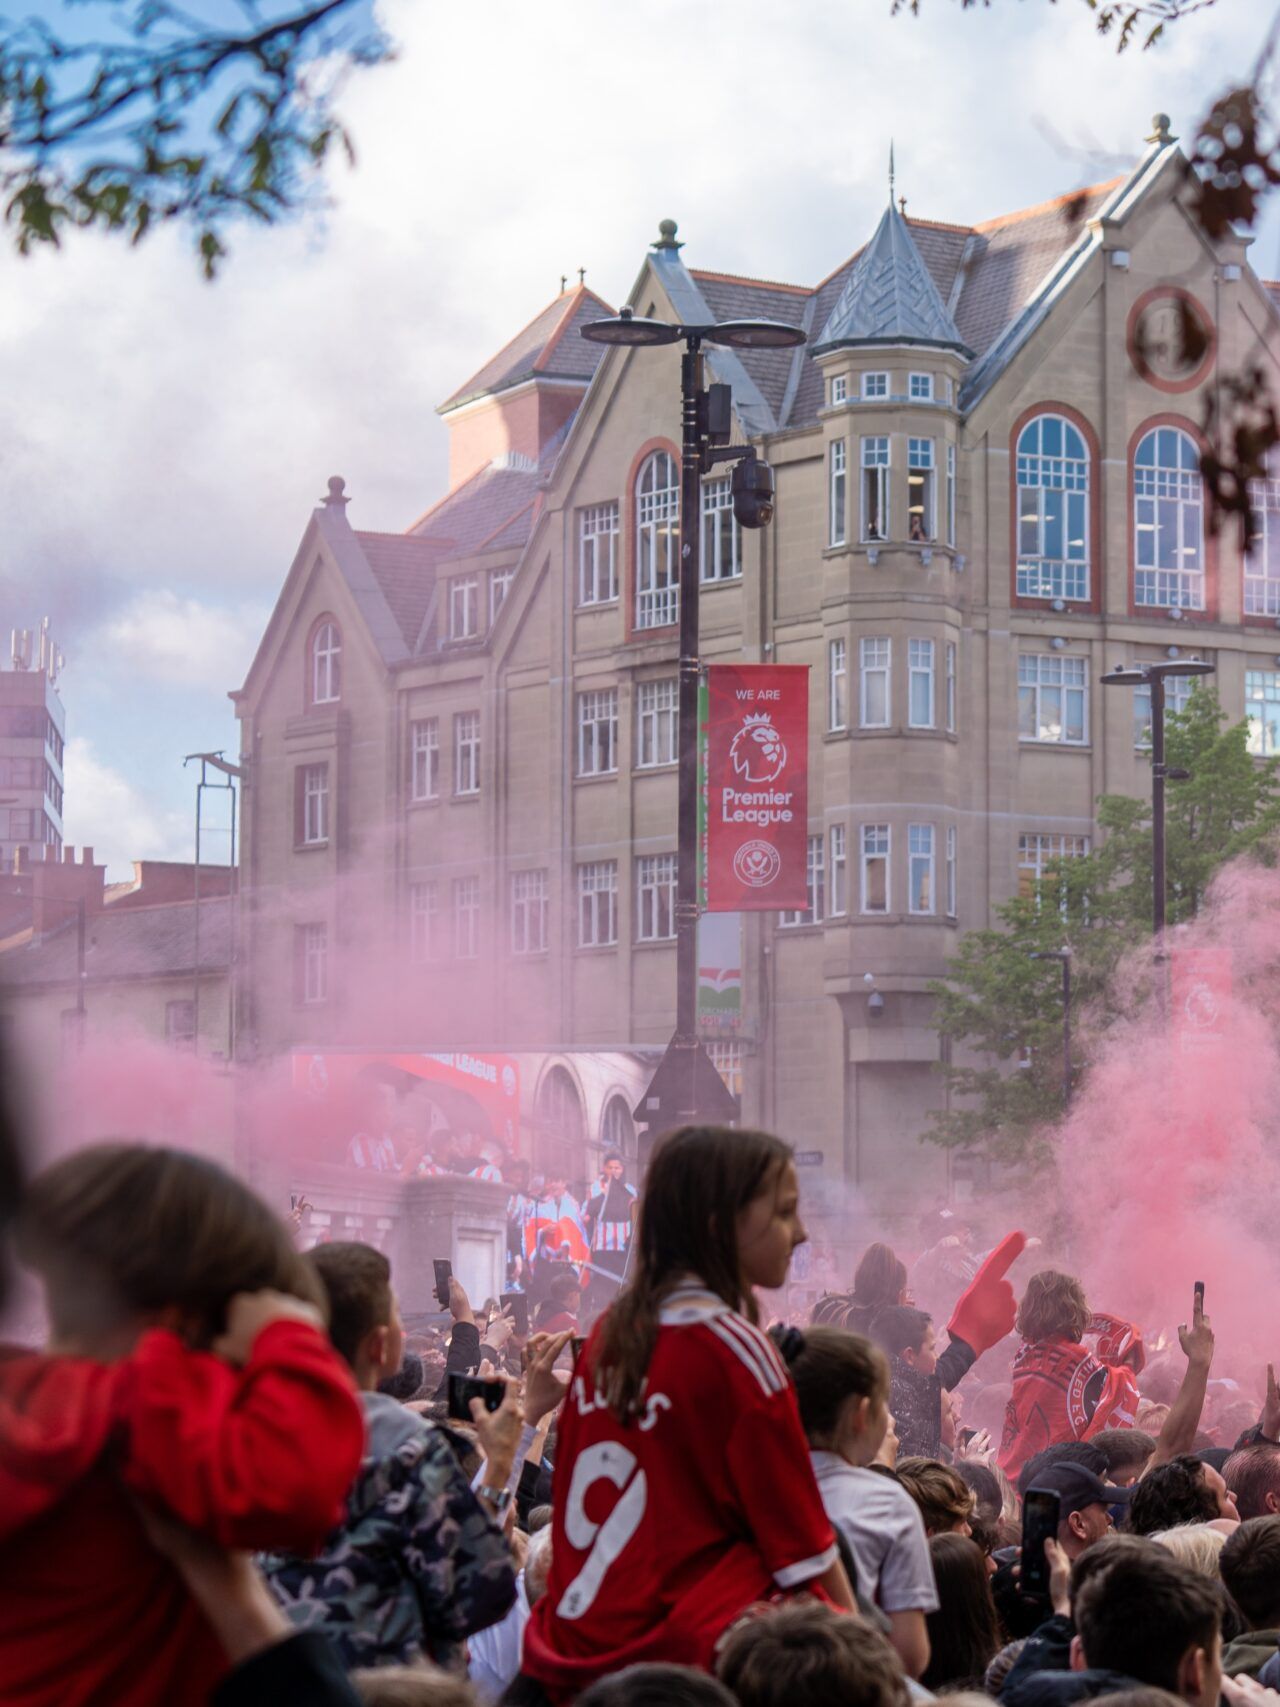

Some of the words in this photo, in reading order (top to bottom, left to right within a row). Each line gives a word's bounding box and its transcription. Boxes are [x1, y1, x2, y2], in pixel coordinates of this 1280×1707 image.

[735, 689, 754, 700] WE
[757, 690, 781, 700] ARE
[722, 787, 793, 806] Premier
[722, 804, 793, 828] League
[455, 1053, 497, 1084] LEAGUE
[556, 1440, 648, 1621] 9
